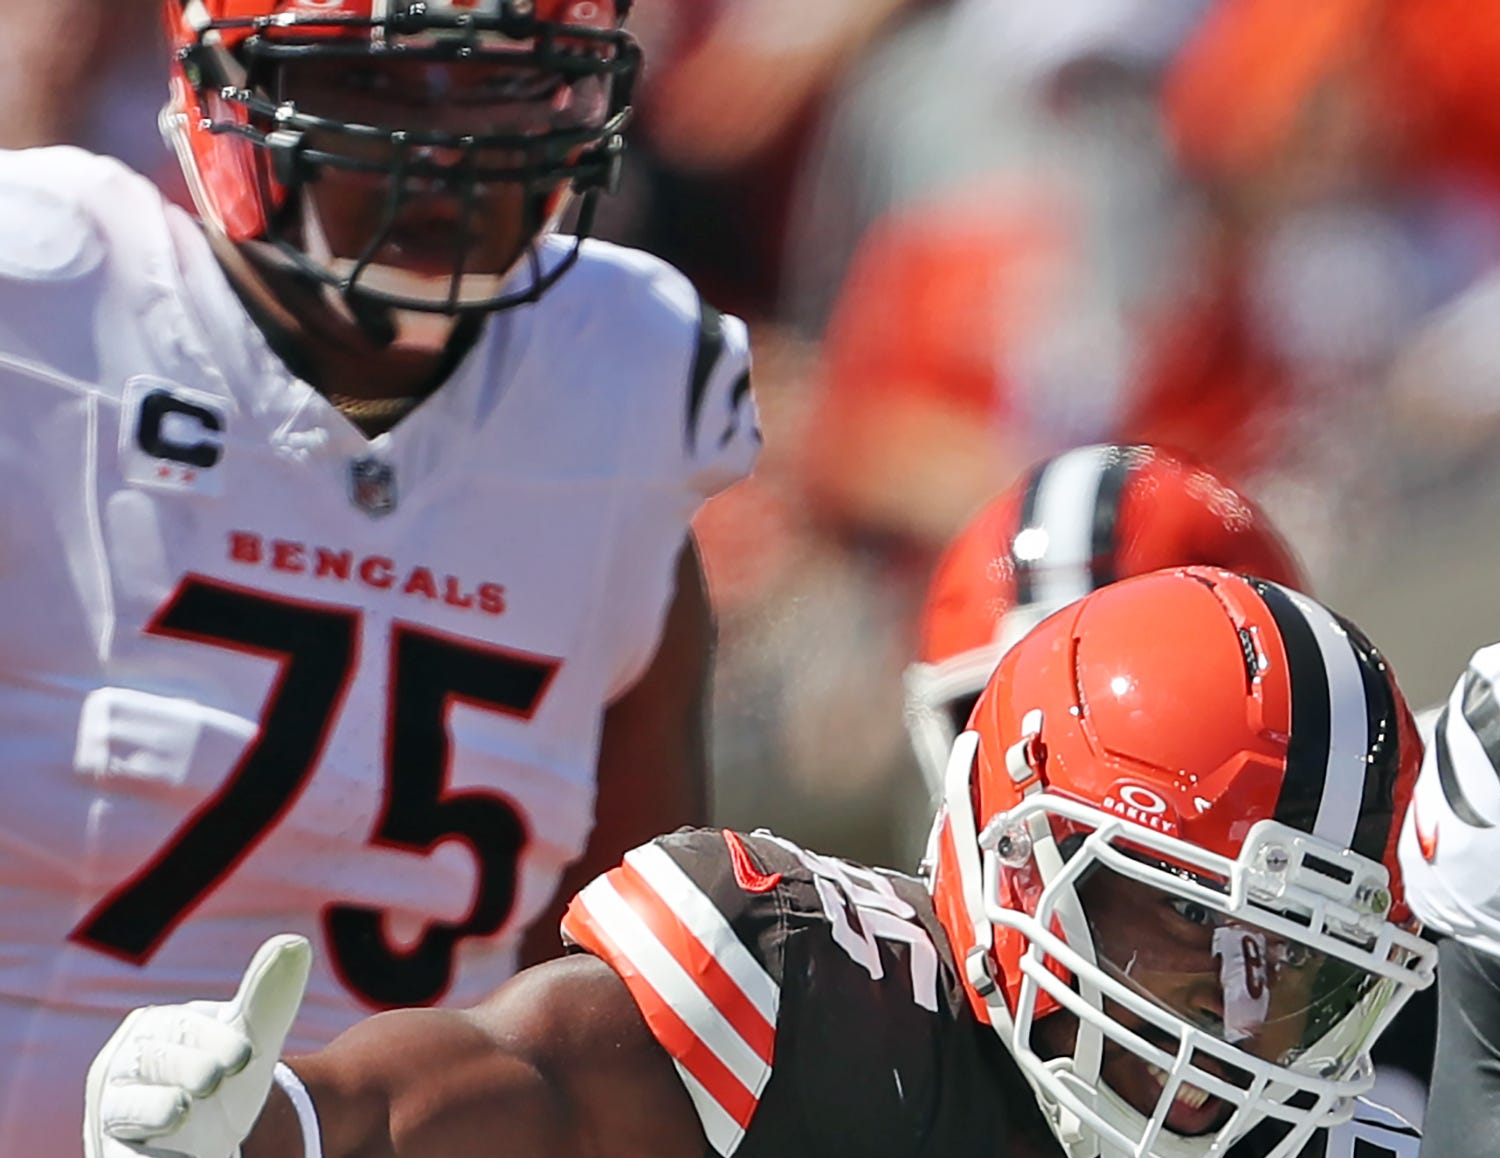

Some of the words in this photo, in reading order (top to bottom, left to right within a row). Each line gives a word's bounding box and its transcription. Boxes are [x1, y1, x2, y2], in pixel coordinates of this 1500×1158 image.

[137, 388, 224, 468] C
[226, 530, 507, 616] BENGALS
[67, 572, 566, 1012] 75
[1103, 796, 1174, 832] OAKLEY
